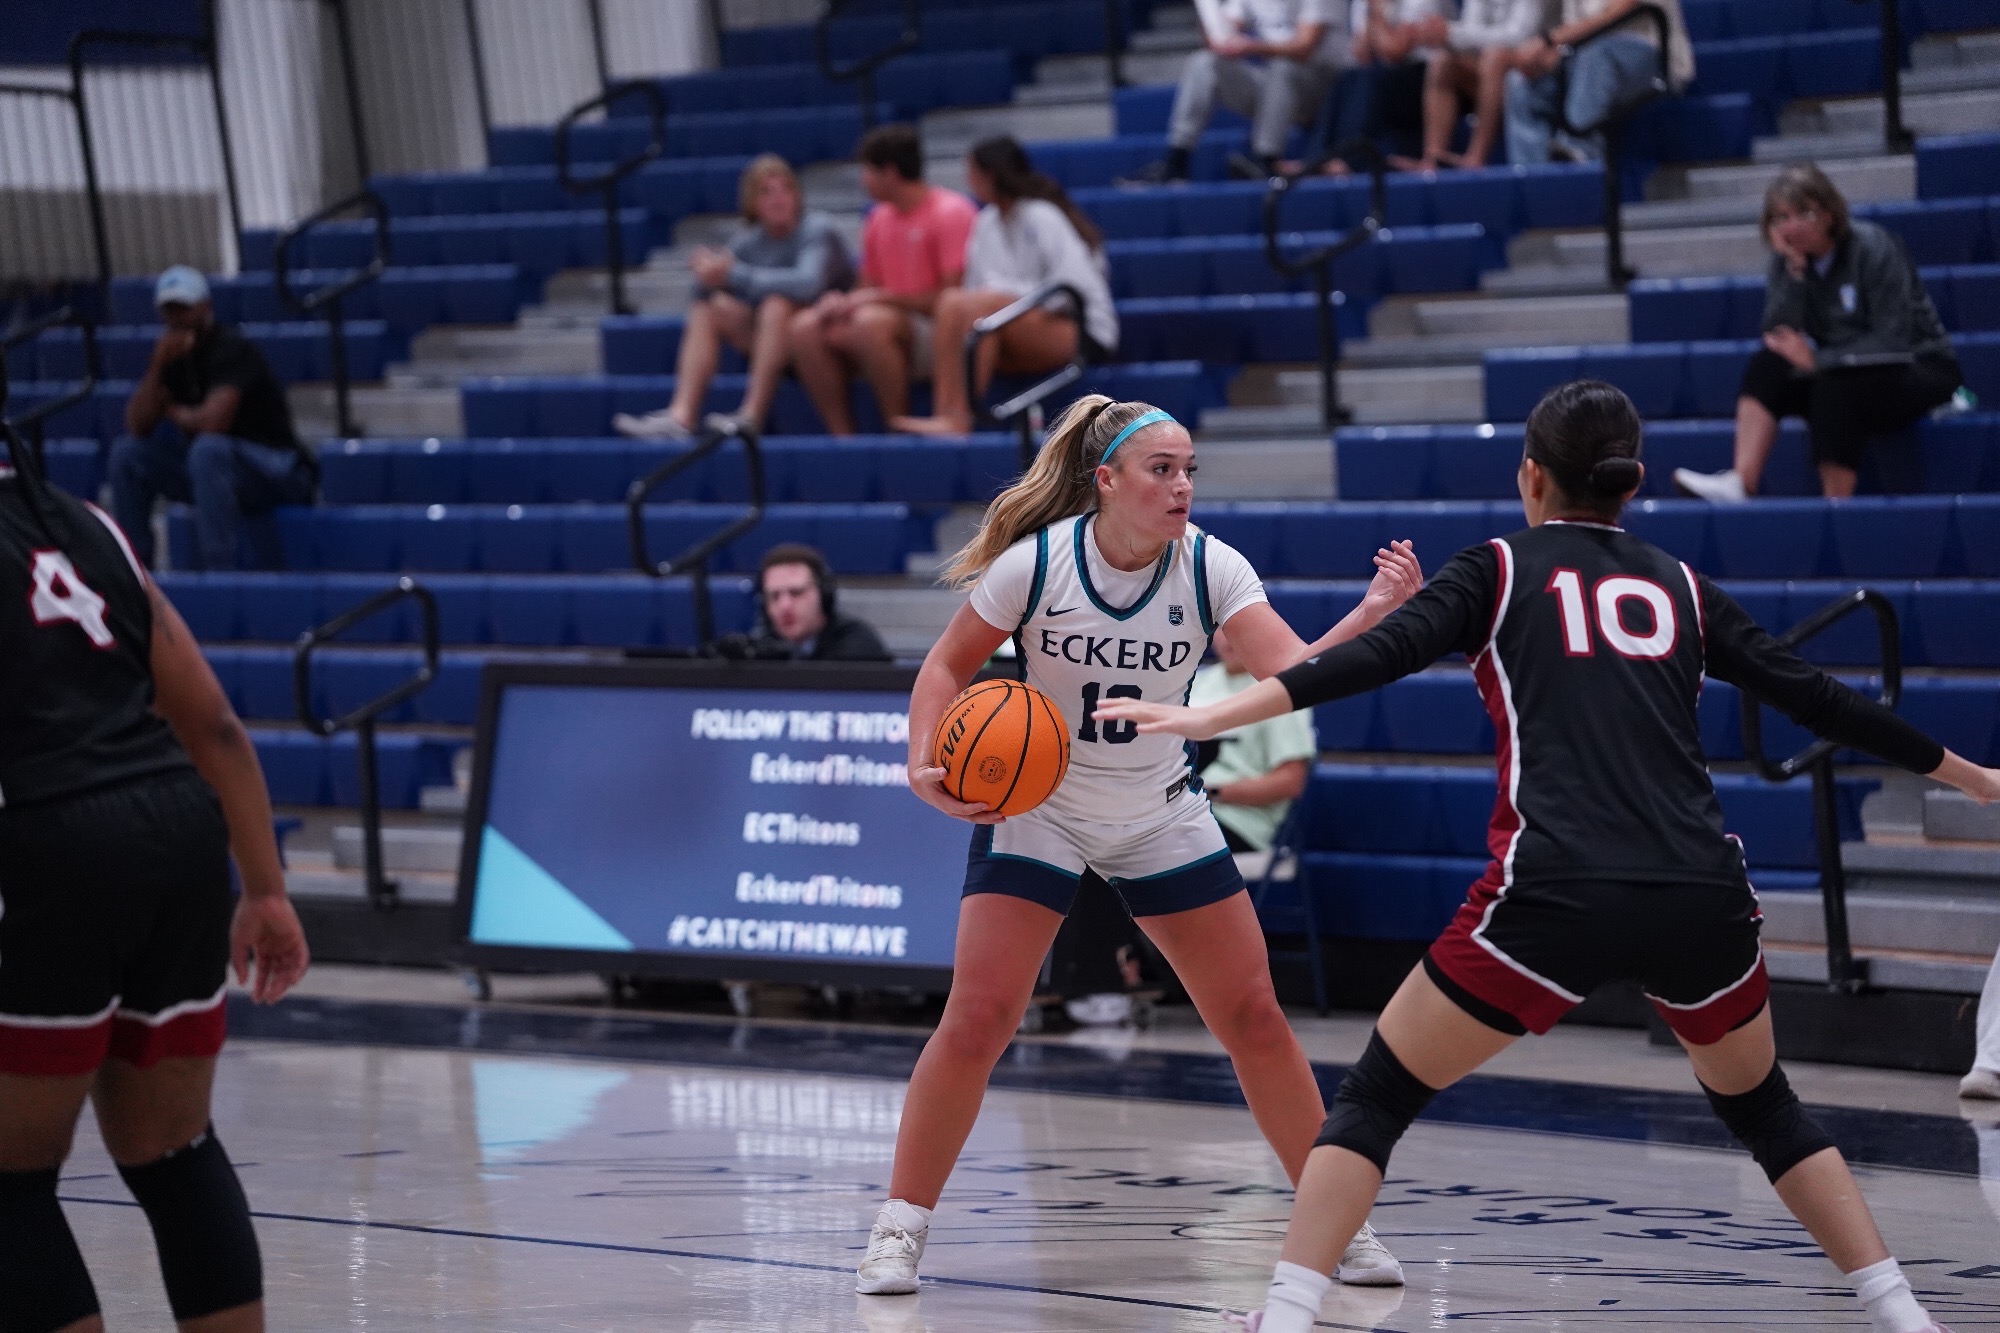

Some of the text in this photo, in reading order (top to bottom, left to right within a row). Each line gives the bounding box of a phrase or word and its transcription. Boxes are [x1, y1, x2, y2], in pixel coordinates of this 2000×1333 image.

[28, 547, 117, 650] 4
[1545, 567, 1679, 661] 10
[1041, 629, 1191, 672] ECKERD
[691, 709, 909, 743] FOLLOW THE TRITO
[743, 812, 861, 846] ECTritons
[735, 871, 902, 909] EckerdTritons
[667, 915, 908, 957] #CATCHTHEWAVE
